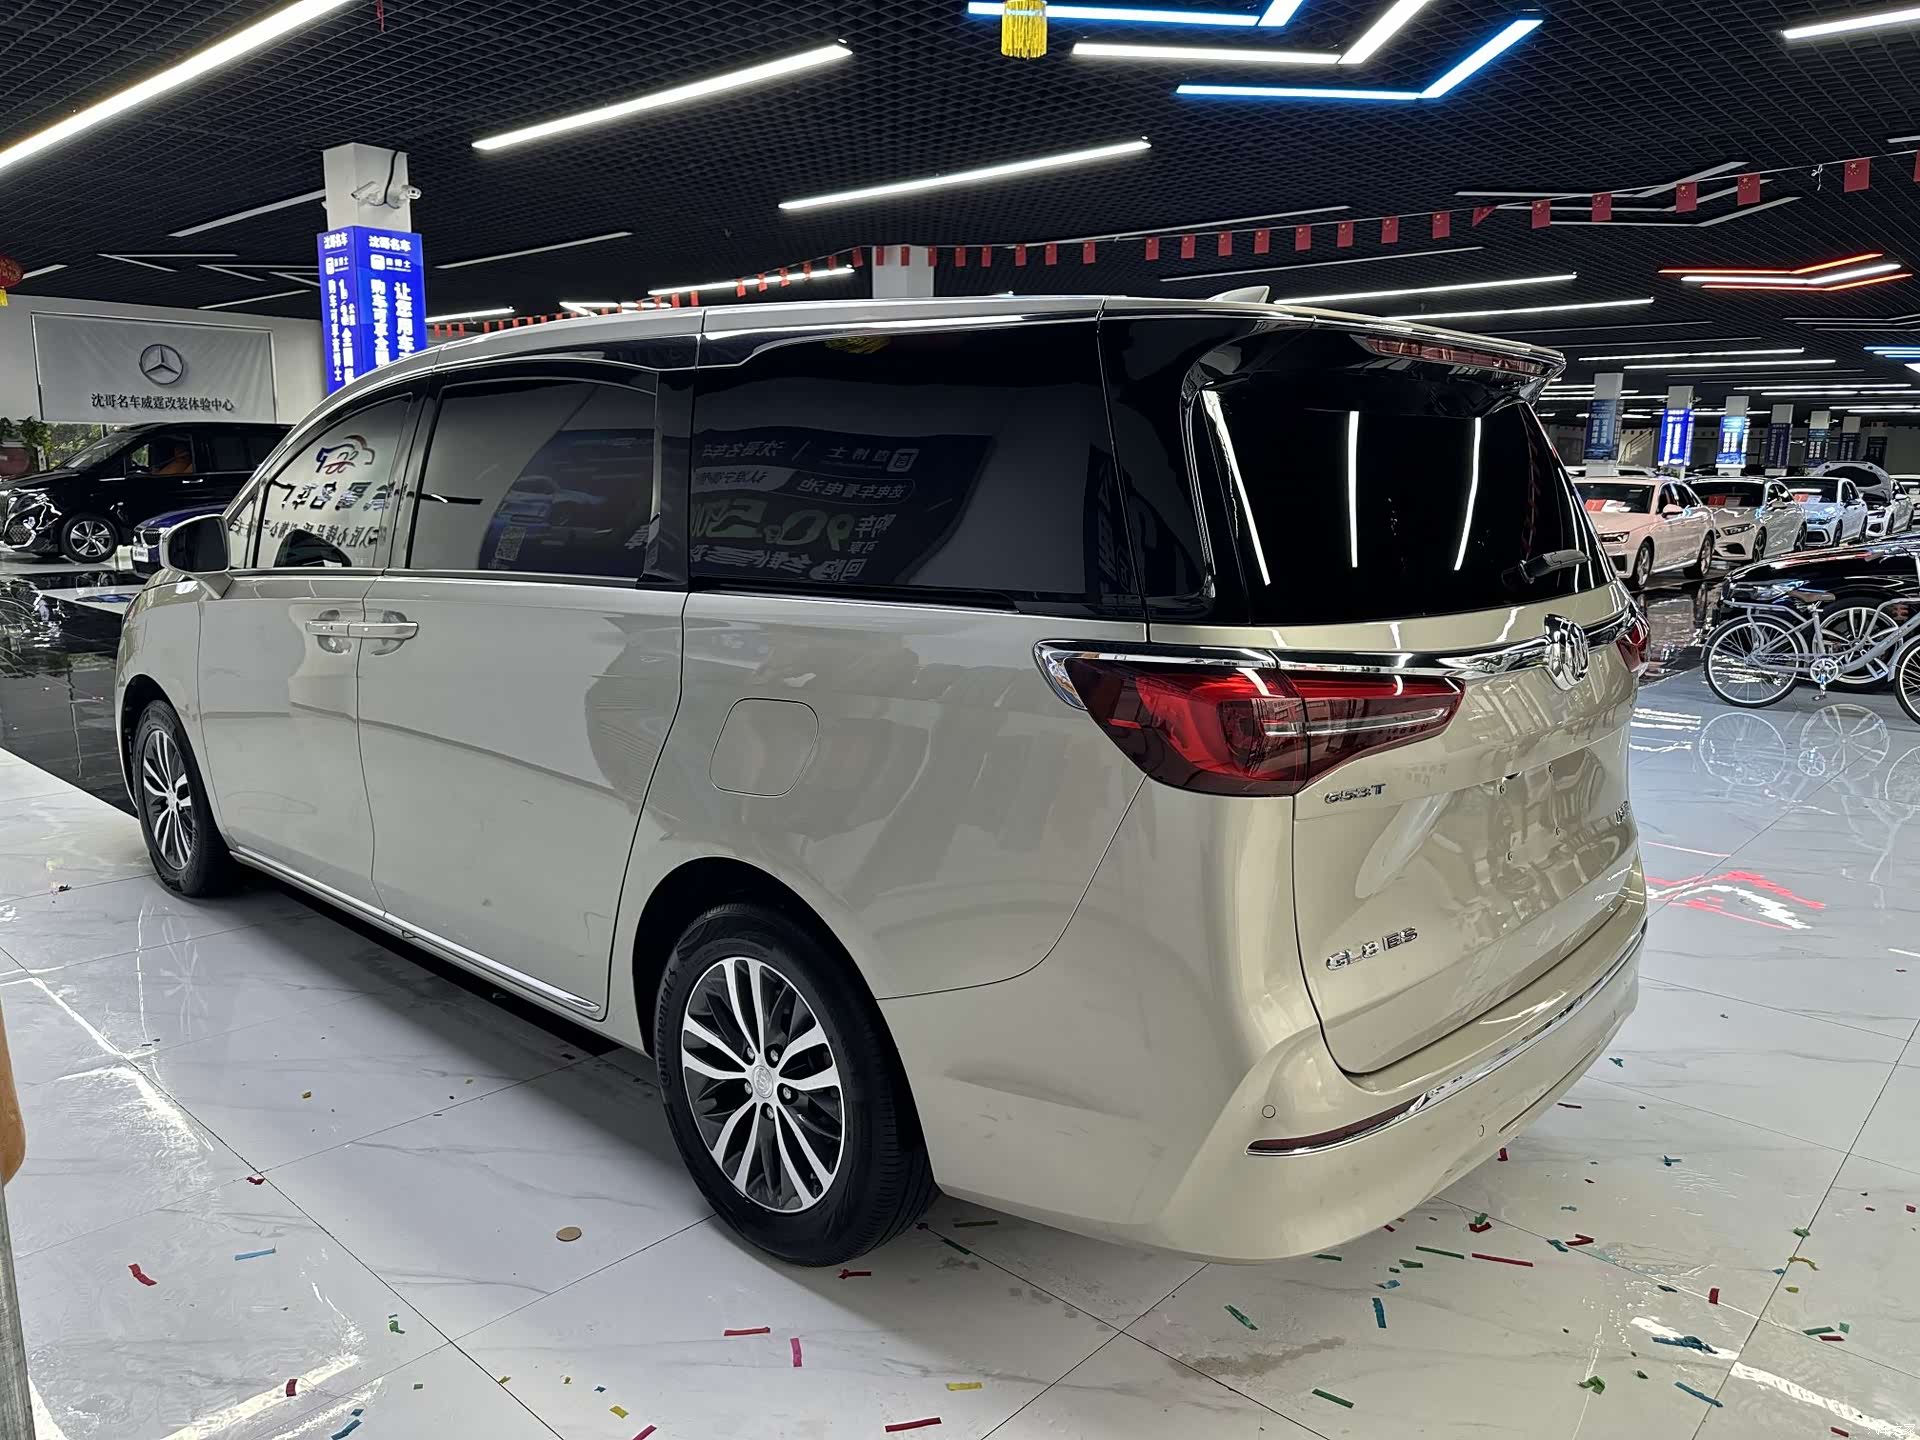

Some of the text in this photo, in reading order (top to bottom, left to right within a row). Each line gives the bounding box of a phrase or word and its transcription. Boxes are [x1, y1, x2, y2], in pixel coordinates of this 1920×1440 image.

[369, 235, 411, 252] 沈哥名车
[91, 393, 234, 412] 沈哥名车威霆改装体验中心
[1325, 926, 1419, 971] GL8 ES
